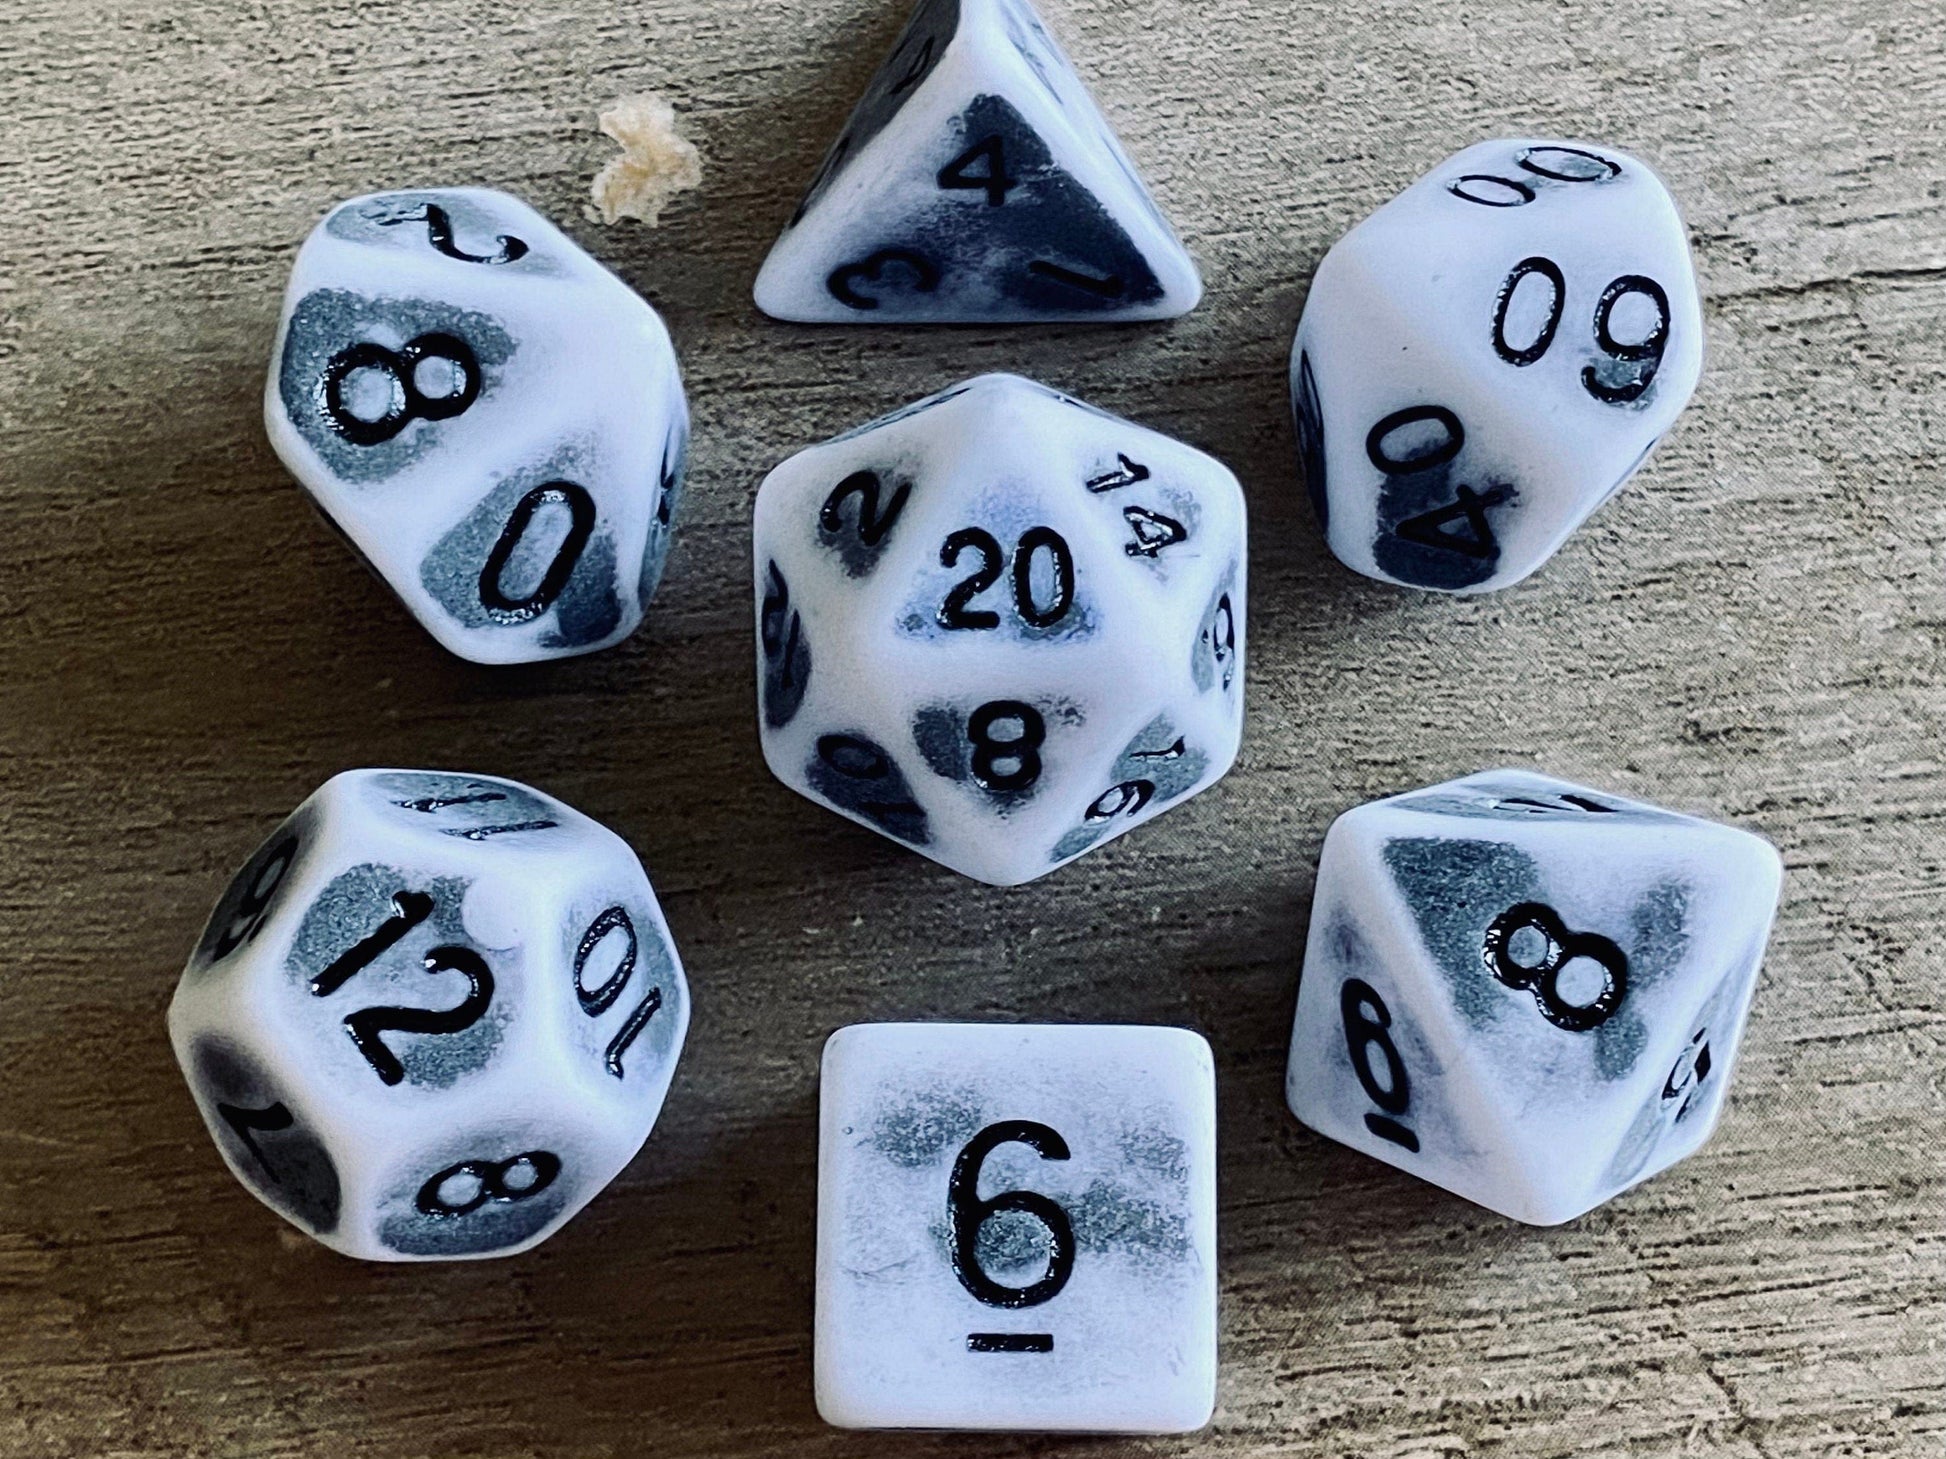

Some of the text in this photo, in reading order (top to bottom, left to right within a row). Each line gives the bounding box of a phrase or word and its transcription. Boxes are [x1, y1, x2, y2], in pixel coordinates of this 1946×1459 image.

[937, 134, 1019, 207] 4
[1446, 146, 1623, 208] 00
[827, 247, 937, 309] 3
[1030, 260, 1123, 298] 1
[313, 332, 480, 446] 8
[479, 480, 596, 623] 0
[819, 470, 912, 546] 2
[939, 526, 1075, 629] 20
[967, 700, 1046, 792] 8
[311, 889, 494, 1087] 12
[573, 904, 662, 1080] 10
[1482, 902, 1628, 1032] 8
[416, 1149, 562, 1218] 8
[947, 1119, 1076, 1309] 6
